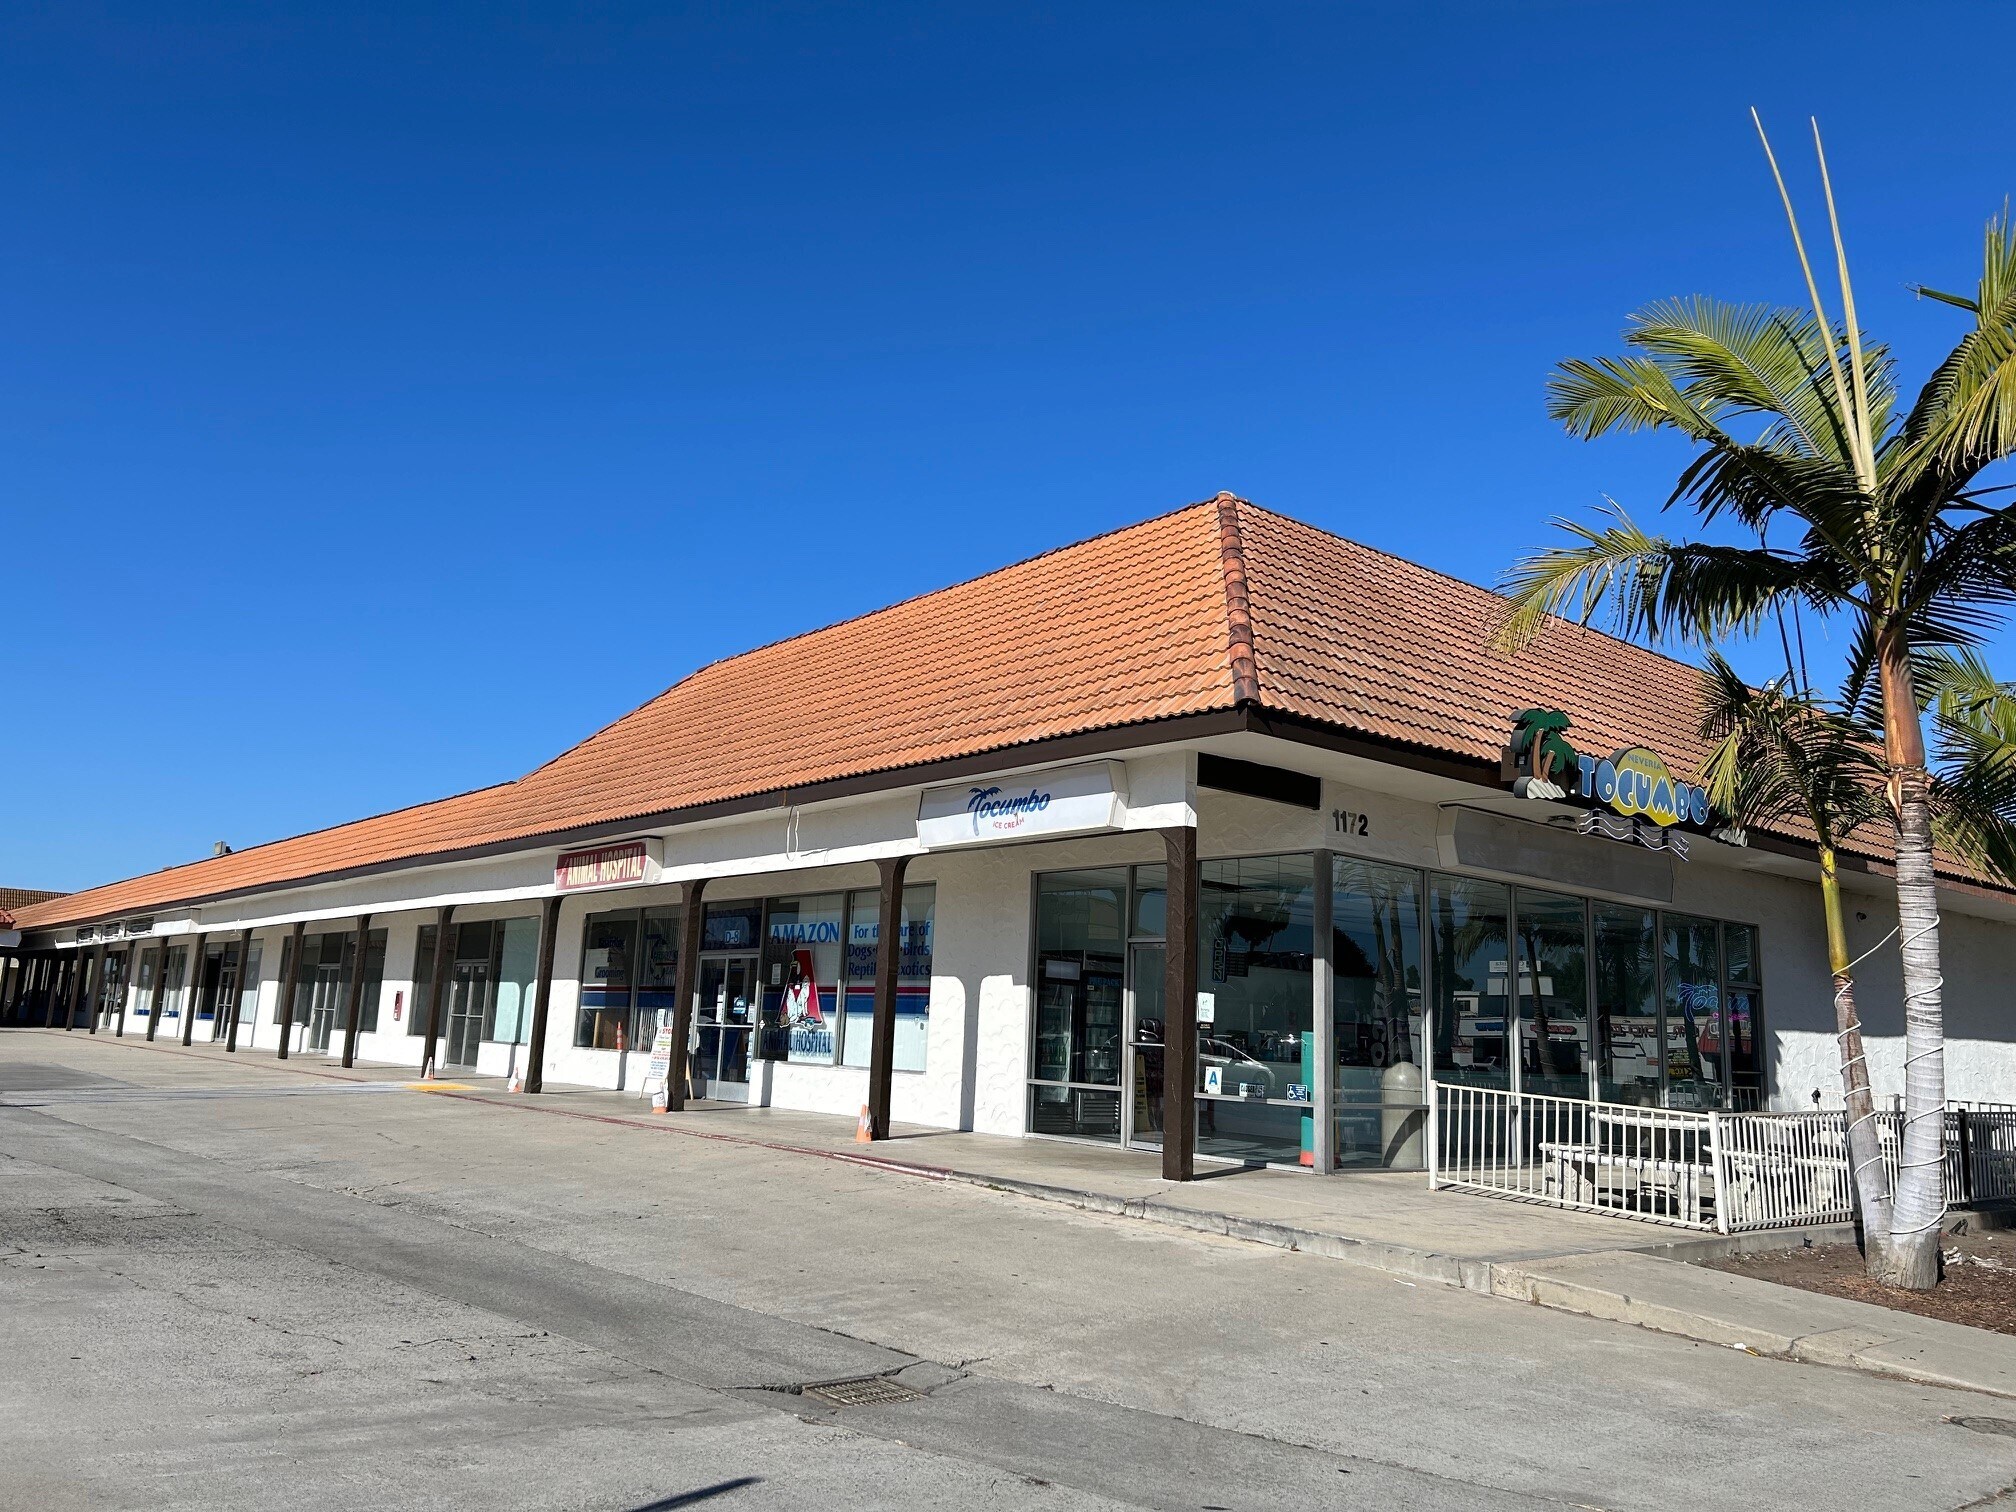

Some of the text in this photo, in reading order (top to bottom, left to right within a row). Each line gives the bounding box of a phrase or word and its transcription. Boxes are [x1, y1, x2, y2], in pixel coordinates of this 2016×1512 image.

[1628, 753, 1663, 771] NEVERIA
[1577, 754, 1709, 826] TOCUMBO
[967, 787, 1051, 836] Tocumbo
[992, 817, 1025, 829] ICE CREAM
[1332, 808, 1369, 837] 1172
[566, 846, 642, 886] ANIMAL HOSPITAL
[770, 921, 840, 944] AMAZON
[854, 925, 869, 939] For
[919, 921, 931, 936] of
[1213, 939, 1223, 981] OPEN
[595, 966, 625, 980] Grooming
[795, 1031, 832, 1054] HOSPITAL
[1209, 1070, 1218, 1086] A
